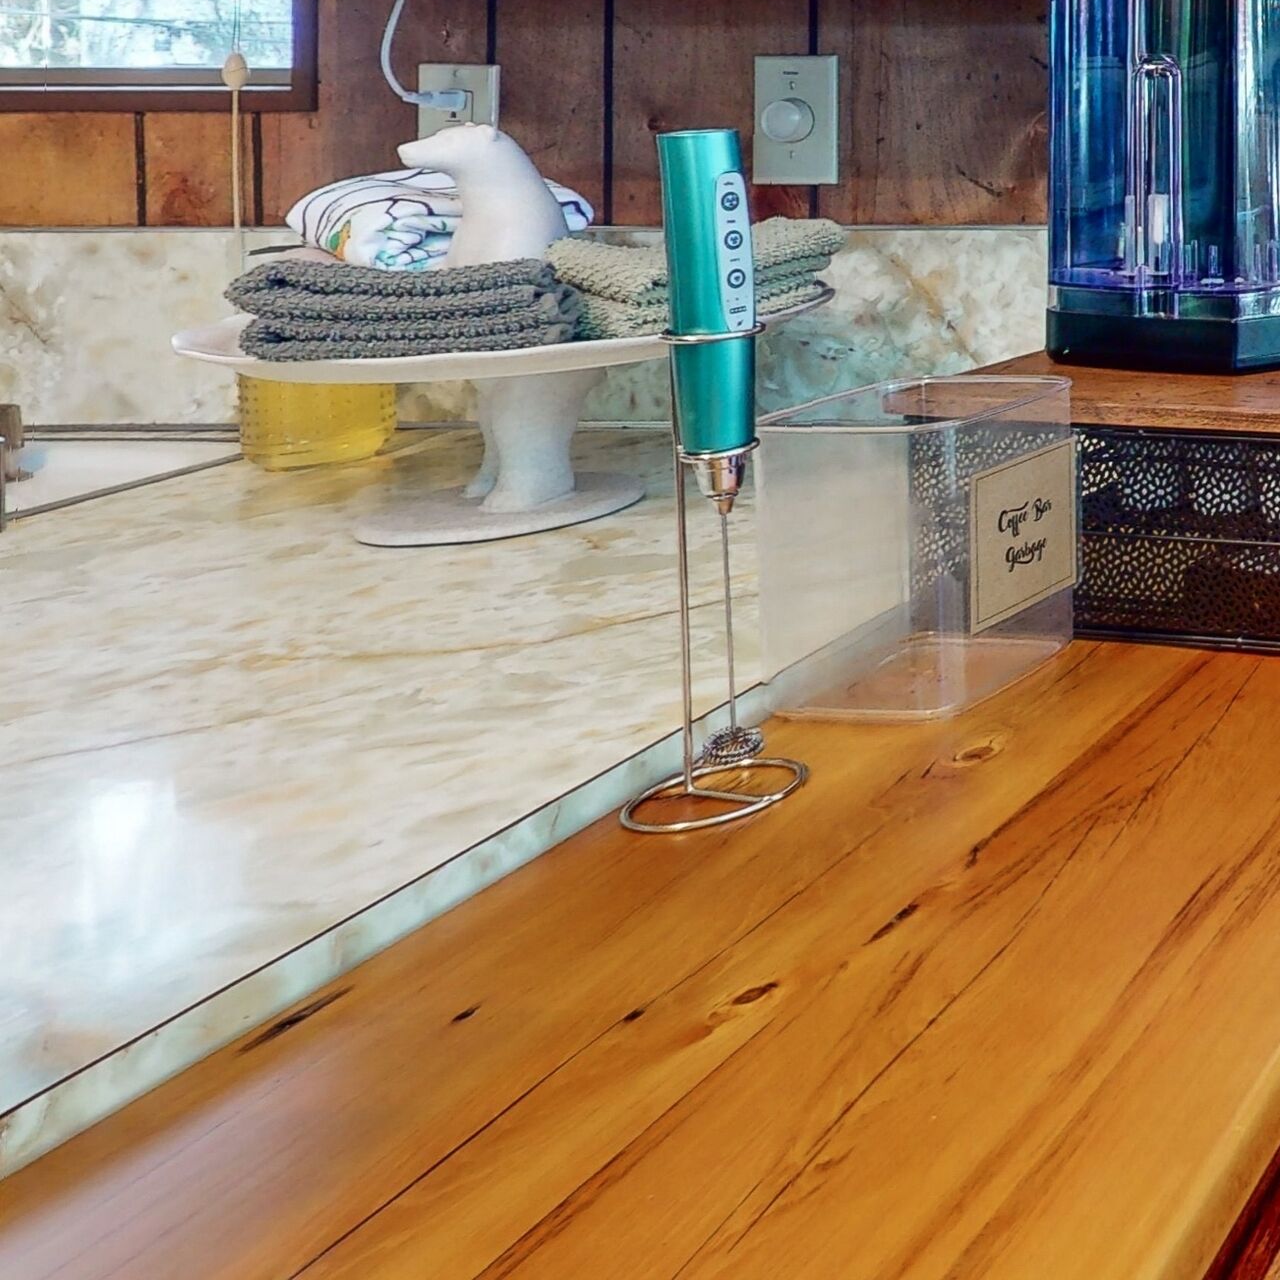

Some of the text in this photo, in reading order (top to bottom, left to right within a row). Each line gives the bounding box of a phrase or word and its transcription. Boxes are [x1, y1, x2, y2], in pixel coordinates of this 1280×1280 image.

[998, 498, 1052, 537] Coffee Bar
[1006, 538, 1046, 573] Garbage
